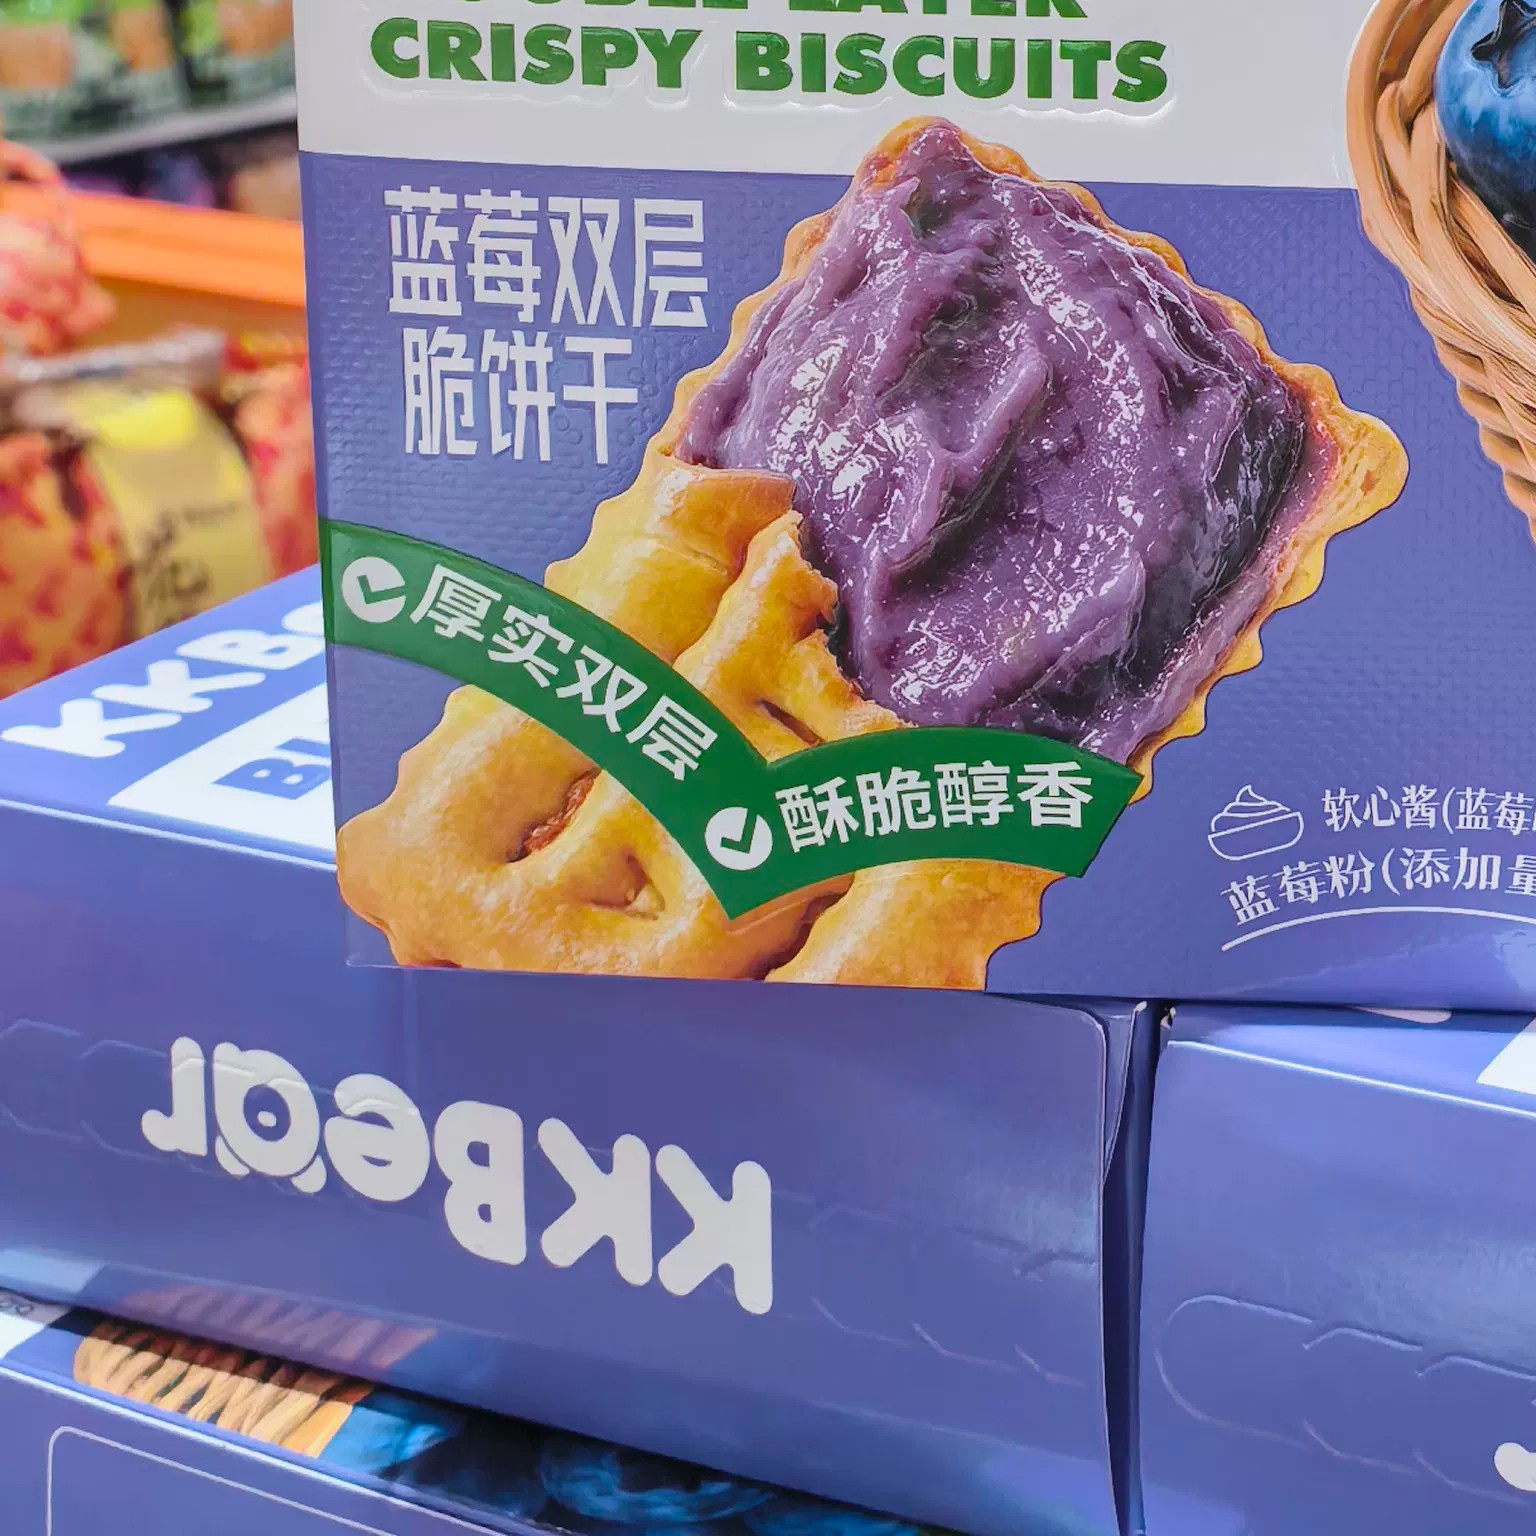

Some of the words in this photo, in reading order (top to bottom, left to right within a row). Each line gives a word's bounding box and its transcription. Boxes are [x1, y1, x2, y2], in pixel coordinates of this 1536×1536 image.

[370, 17, 702, 90] CRISPY
[734, 29, 1168, 103] BISCUITS
[384, 184, 708, 328] 蓝莓双层
[402, 327, 639, 464] 脆饼干
[409, 563, 720, 782] 厚实双层
[775, 759, 1093, 853] 酥脆醇香
[140, 1036, 773, 1315] KKBear
